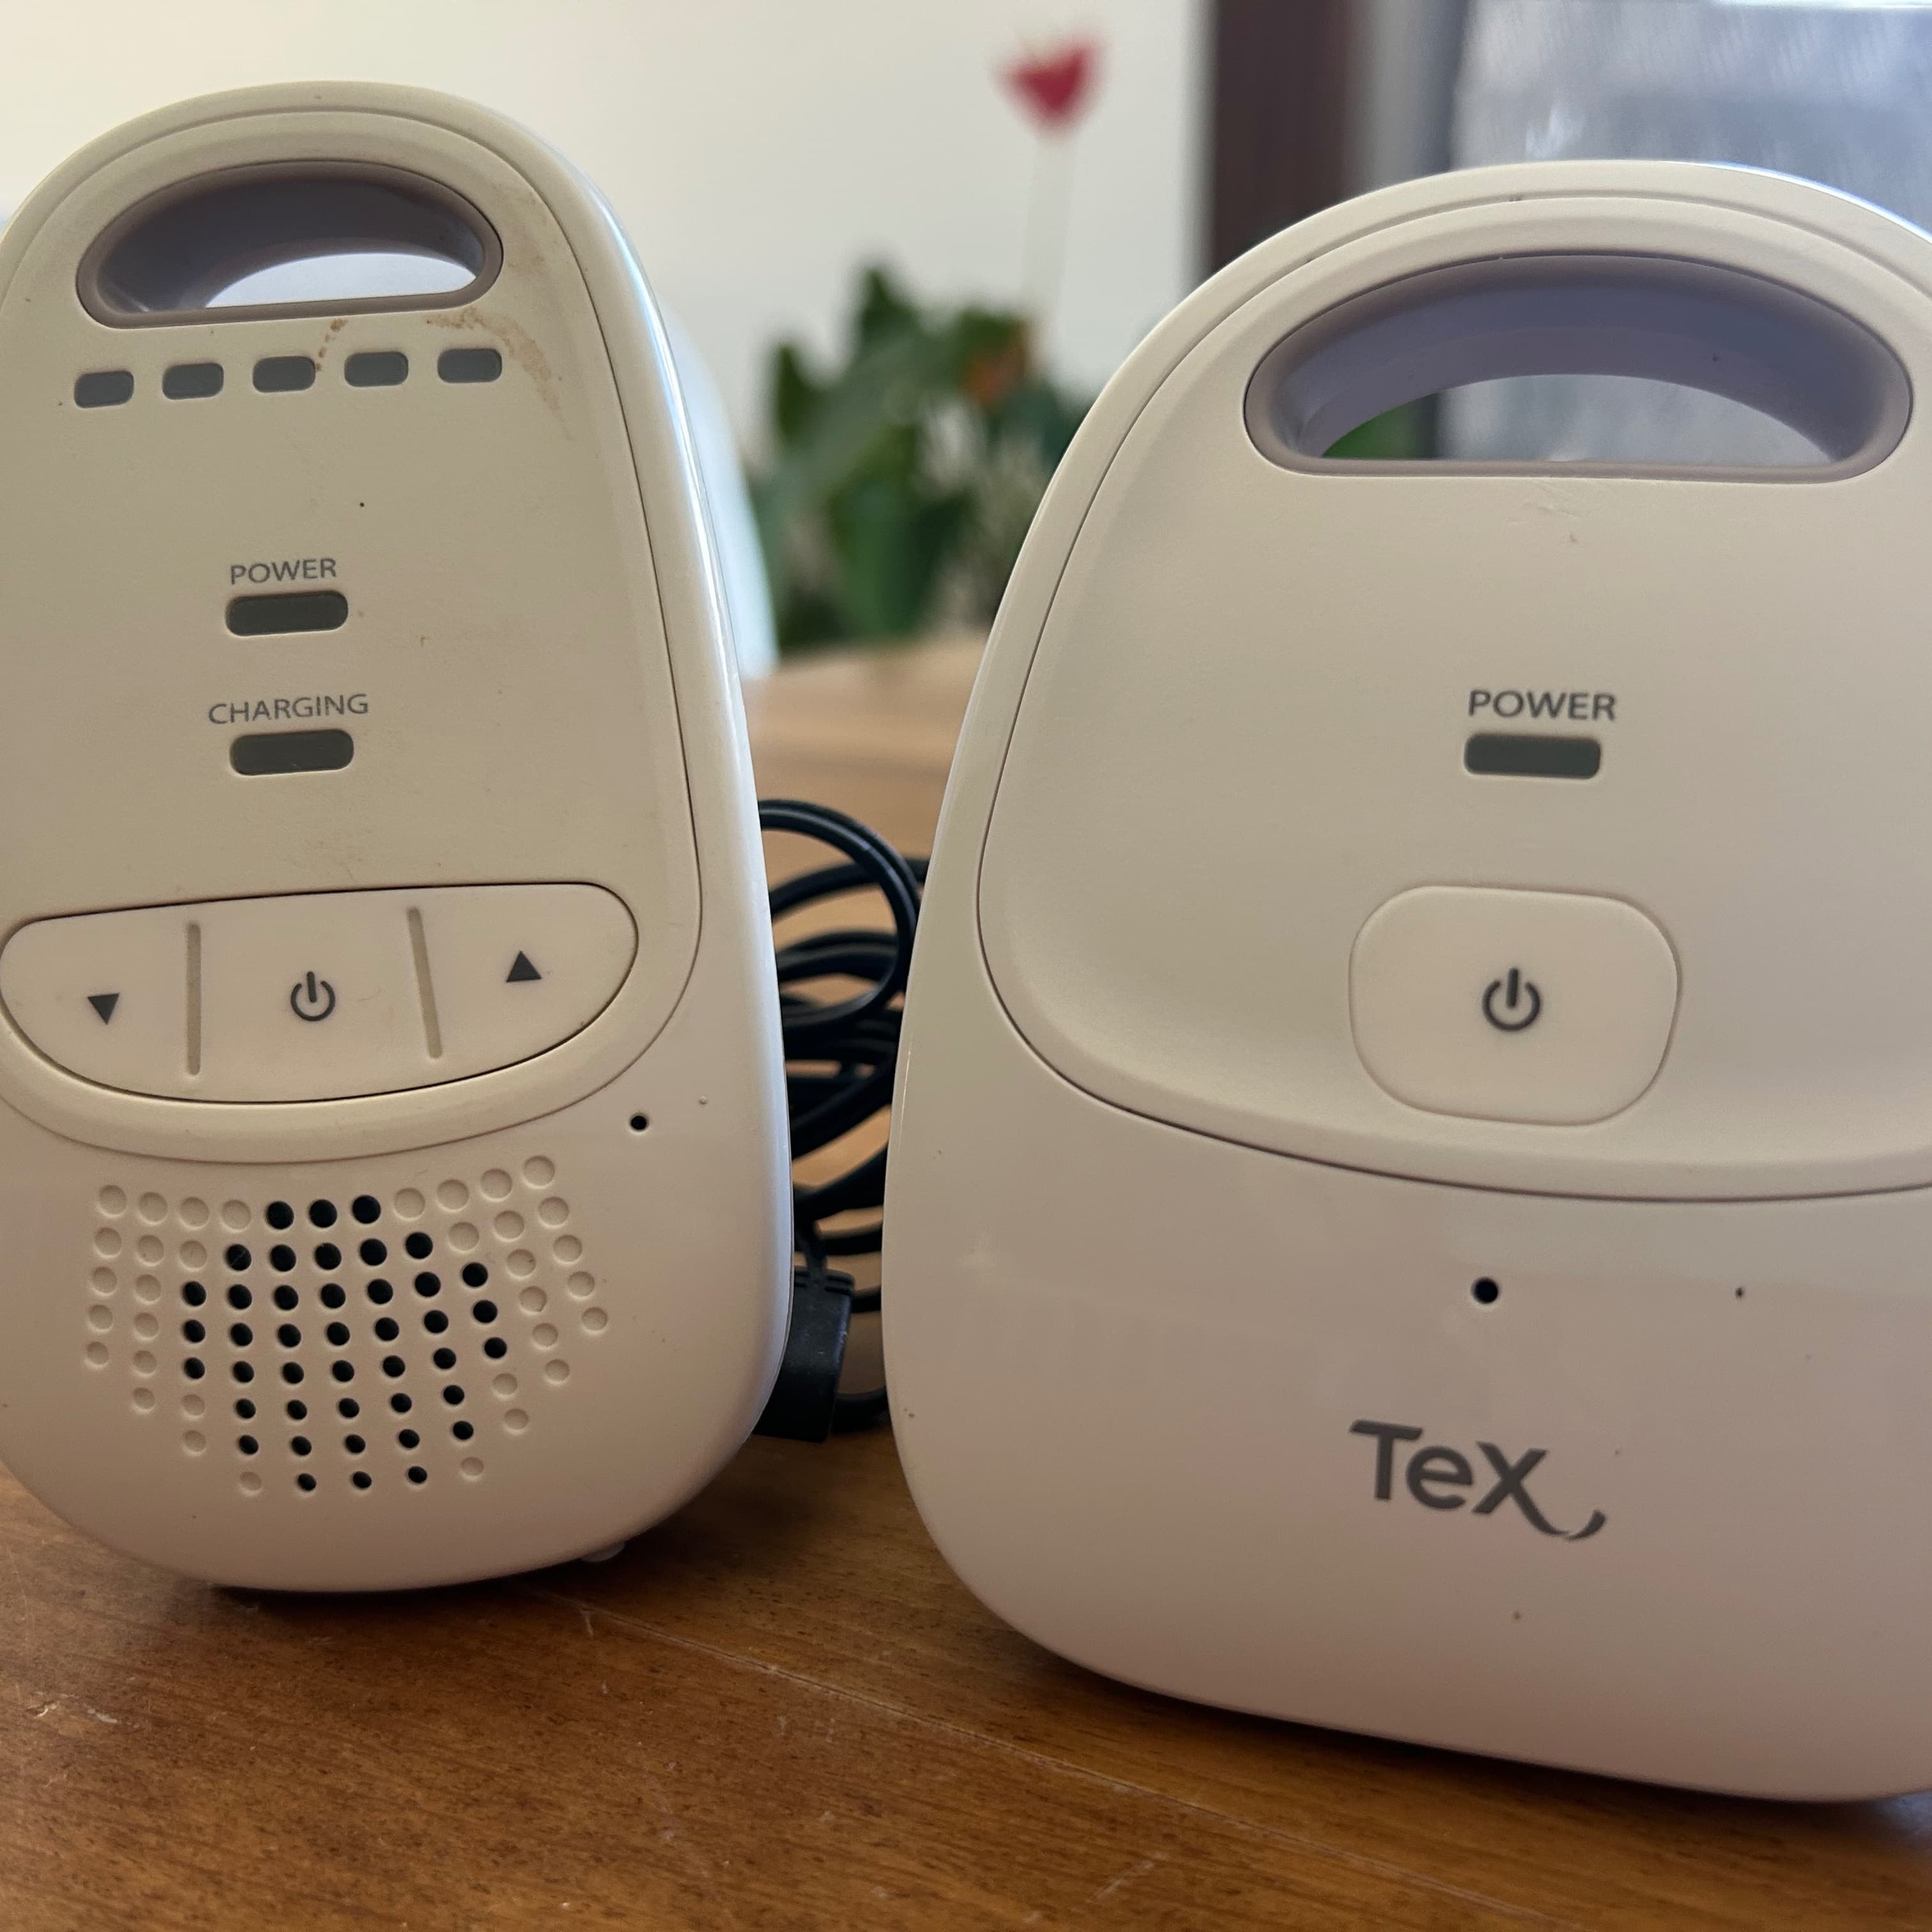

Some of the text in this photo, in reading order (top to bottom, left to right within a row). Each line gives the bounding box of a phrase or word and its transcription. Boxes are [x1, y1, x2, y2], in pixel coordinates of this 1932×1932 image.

[230, 558, 337, 585] POWER
[208, 693, 369, 724] CHARGING
[1468, 689, 1616, 721] POWER
